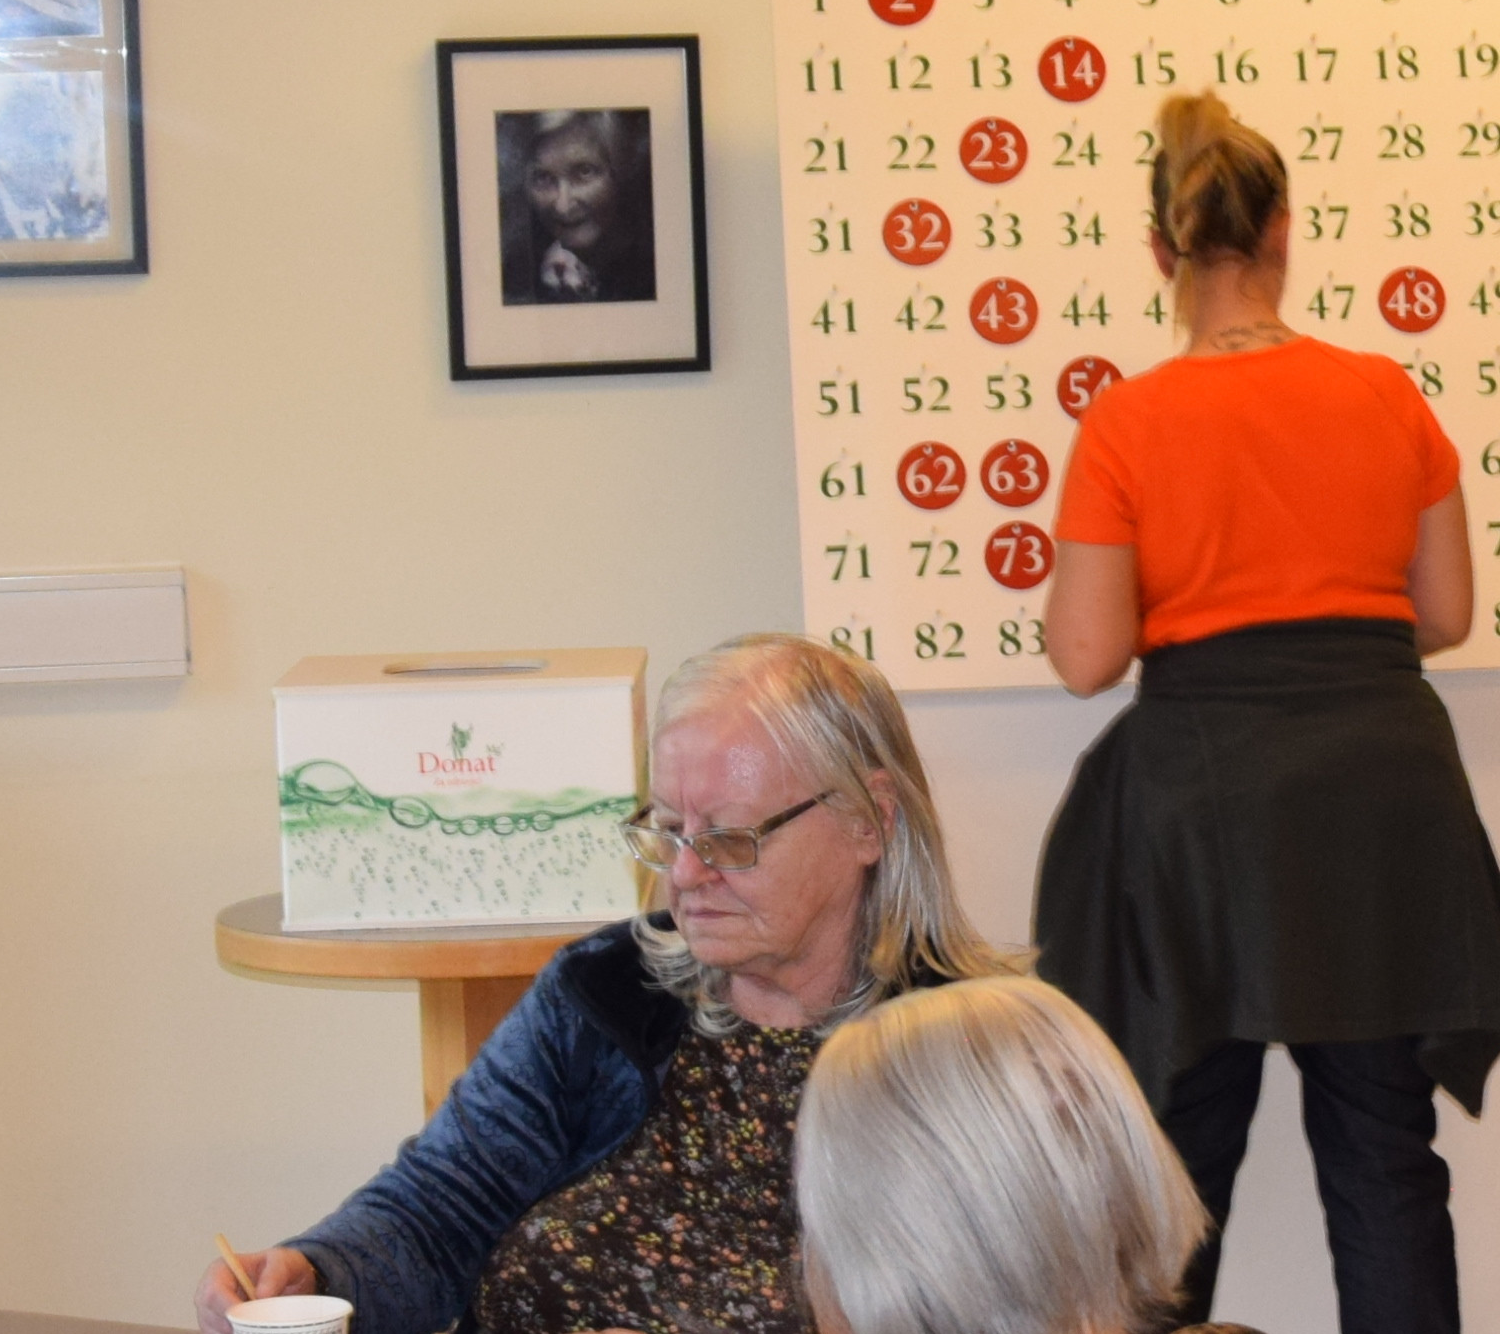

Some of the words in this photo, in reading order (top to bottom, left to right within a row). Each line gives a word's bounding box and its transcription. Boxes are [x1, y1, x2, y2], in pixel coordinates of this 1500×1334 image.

[802, 58, 843, 91] 11
[886, 55, 932, 89] 12
[968, 53, 1012, 88] 13
[1050, 51, 1098, 87] 14
[1132, 51, 1176, 86] 15
[1213, 49, 1259, 83] 16
[1295, 48, 1337, 82] 17
[1375, 45, 1419, 79] 18
[1454, 44, 1500, 78] 19
[804, 137, 847, 172] 21
[888, 135, 937, 169] 22
[969, 132, 1018, 168] 23
[1052, 132, 1101, 165] 24
[1297, 127, 1343, 161] 27
[1379, 124, 1425, 158] 28
[809, 218, 852, 253] 31
[893, 214, 945, 251] 32
[976, 213, 1023, 247] 33
[1059, 211, 1106, 246] 34
[1302, 206, 1349, 240] 37
[1384, 202, 1431, 237] 38
[810, 299, 858, 334] 41
[895, 296, 948, 332] 42
[977, 293, 1027, 330] 43
[1061, 292, 1111, 327] 44
[1307, 286, 1355, 320] 47
[1386, 282, 1438, 319] 48
[817, 379, 861, 415] 51
[902, 376, 951, 412] 52
[984, 374, 1032, 409] 53
[820, 462, 866, 497] 61
[904, 455, 960, 496] 62
[988, 454, 1039, 493] 63
[825, 544, 871, 580] 71
[909, 540, 961, 577] 72
[992, 536, 1044, 576] 73
[915, 622, 966, 659] 82
[999, 620, 1046, 657] 83
[417, 751, 497, 774] Donat
